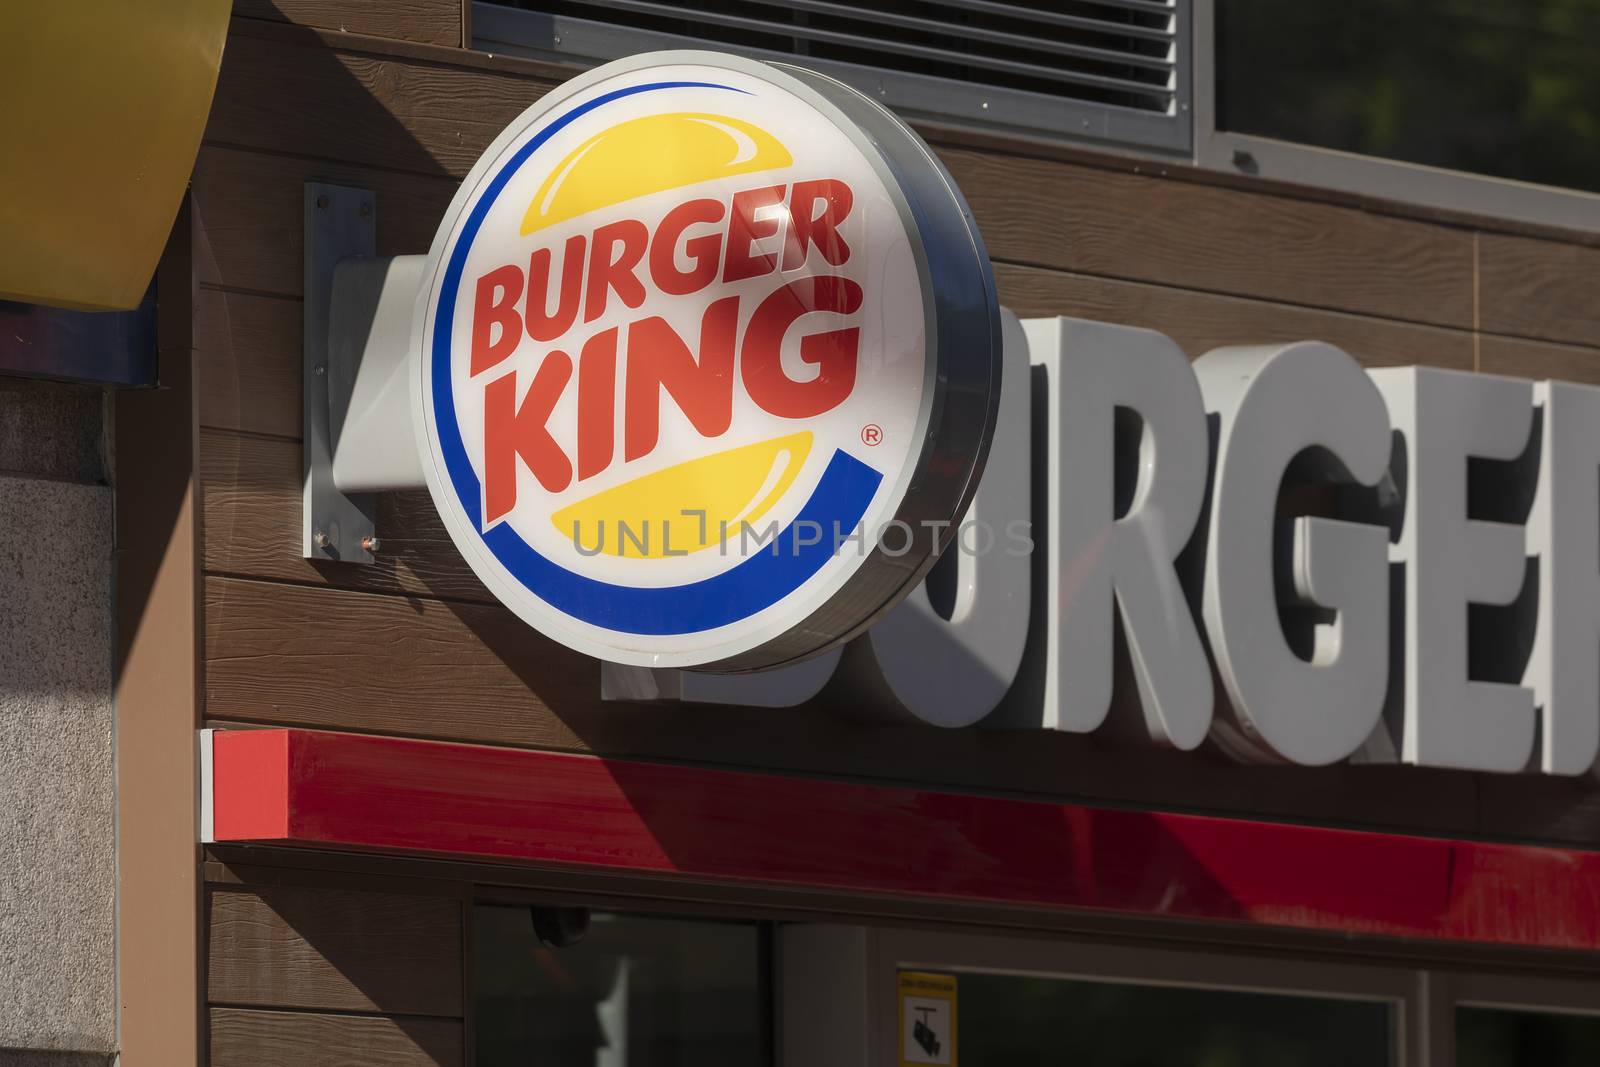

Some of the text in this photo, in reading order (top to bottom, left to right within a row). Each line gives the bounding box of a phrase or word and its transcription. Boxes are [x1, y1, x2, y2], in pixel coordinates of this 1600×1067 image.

[469, 178, 854, 378] BURGER
[482, 275, 864, 525] KING
[602, 306, 1600, 776] URGE
